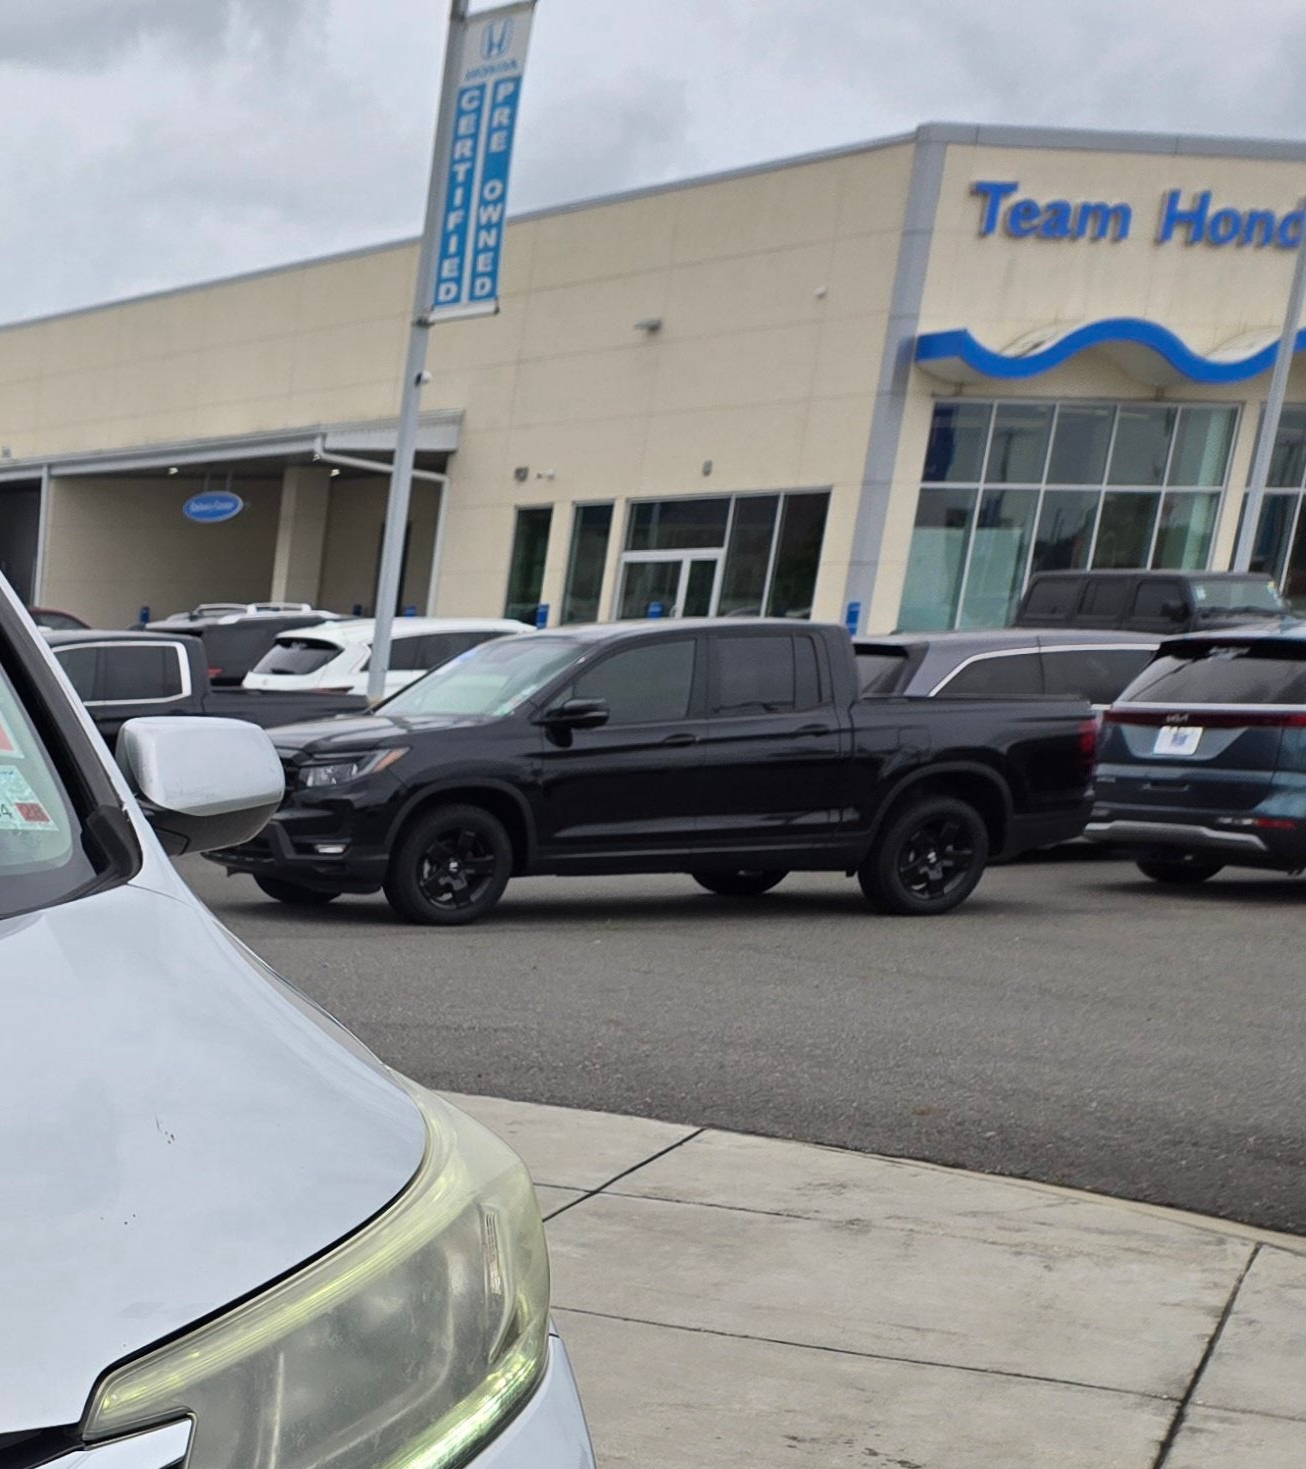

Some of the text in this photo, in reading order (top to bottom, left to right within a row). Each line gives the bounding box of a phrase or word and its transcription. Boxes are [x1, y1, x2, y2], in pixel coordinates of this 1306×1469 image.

[437, 89, 482, 303] CERTIFIED
[474, 81, 516, 298] PRE OWNED
[972, 180, 1133, 240] Team
